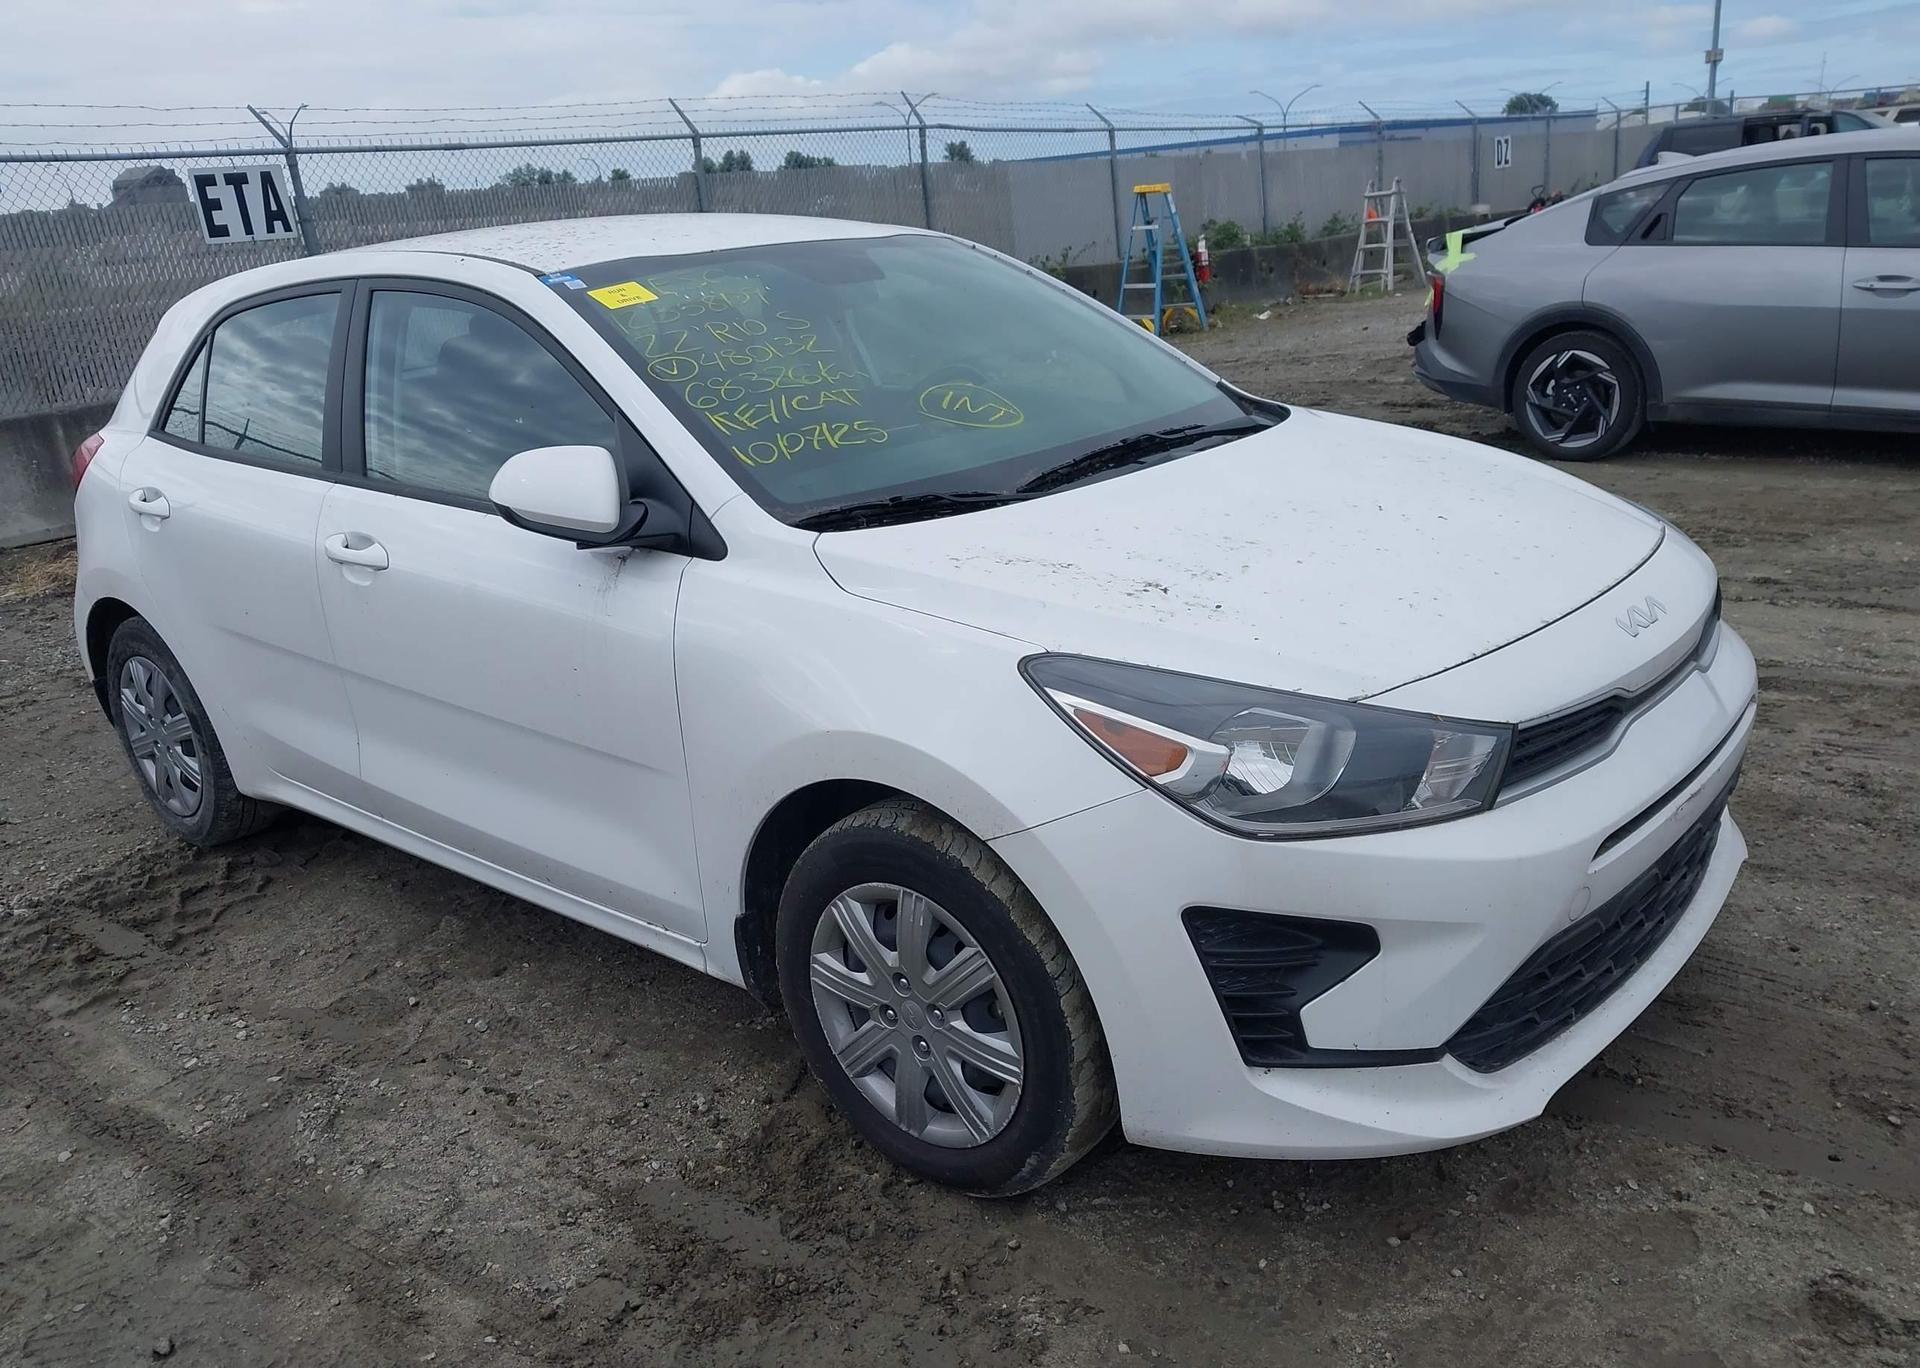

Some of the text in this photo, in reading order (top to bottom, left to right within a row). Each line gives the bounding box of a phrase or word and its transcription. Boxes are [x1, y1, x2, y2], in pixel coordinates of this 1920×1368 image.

[1496, 138, 1510, 166] DZ
[193, 171, 293, 239] ETA
[704, 319, 767, 344] RIO
[776, 311, 810, 330] S
[700, 334, 836, 371] 480132
[1615, 596, 1668, 638] KIA
